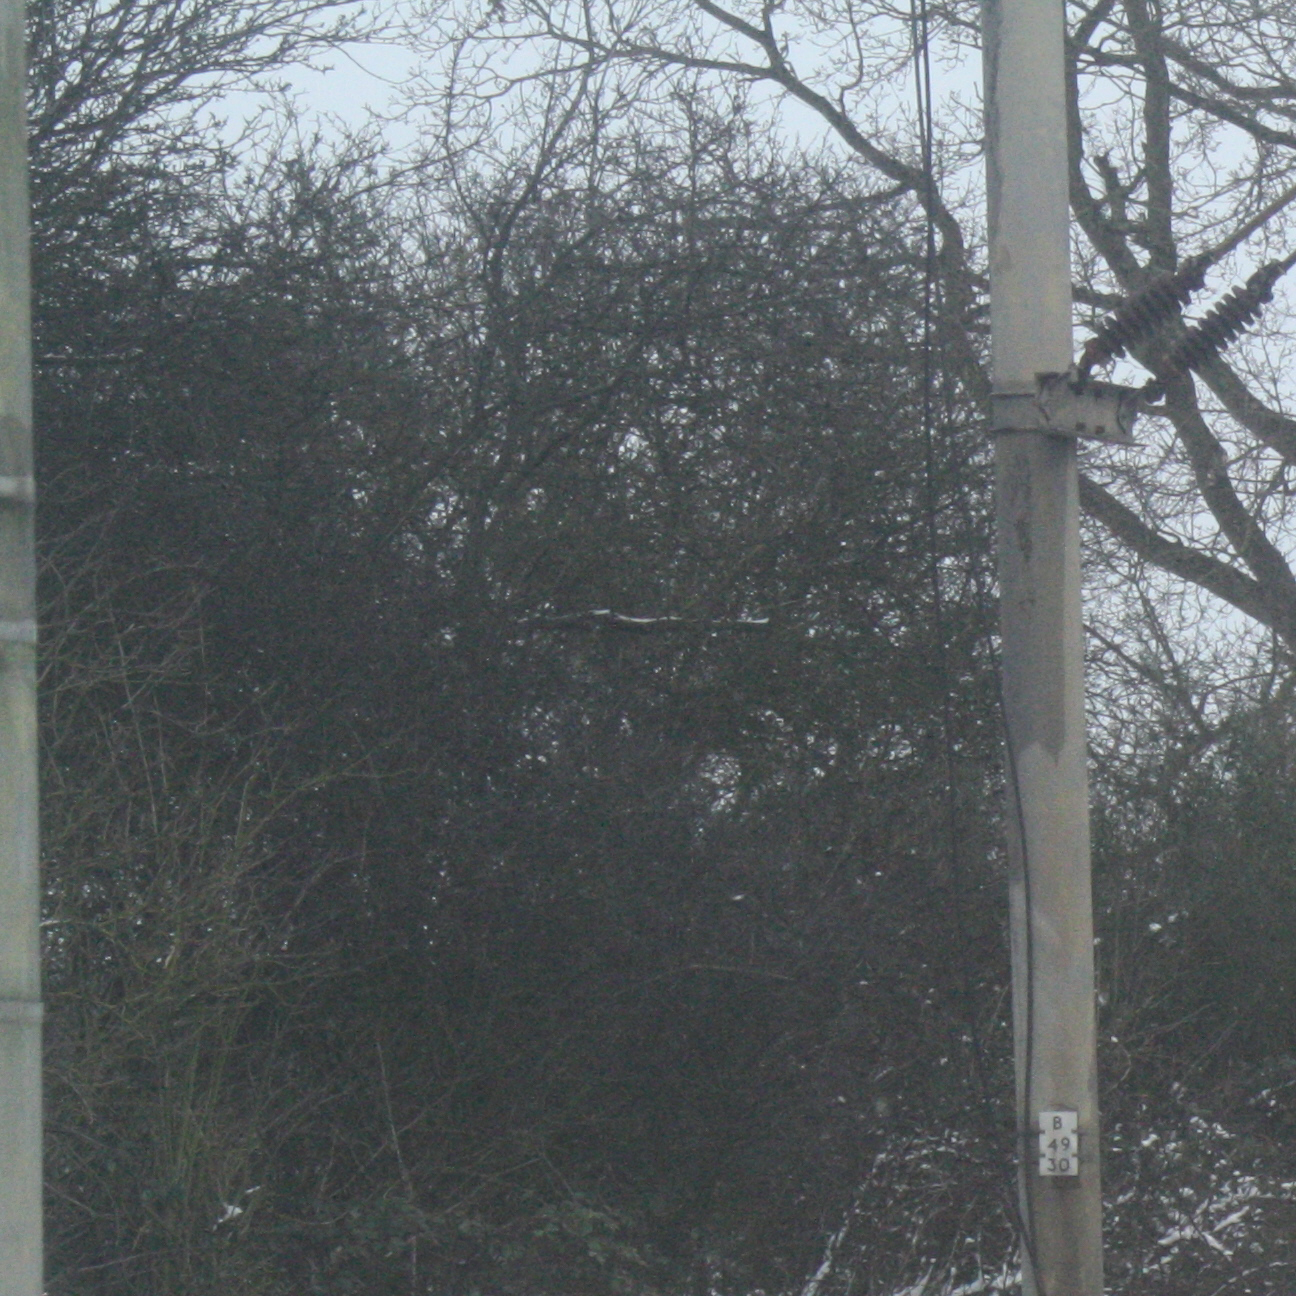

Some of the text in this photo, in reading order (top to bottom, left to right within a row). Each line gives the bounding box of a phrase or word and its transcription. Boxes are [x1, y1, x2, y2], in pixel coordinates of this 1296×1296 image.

[1053, 1116, 1062, 1130] B
[1047, 1136, 1070, 1151] 49
[1047, 1158, 1070, 1172] 30
